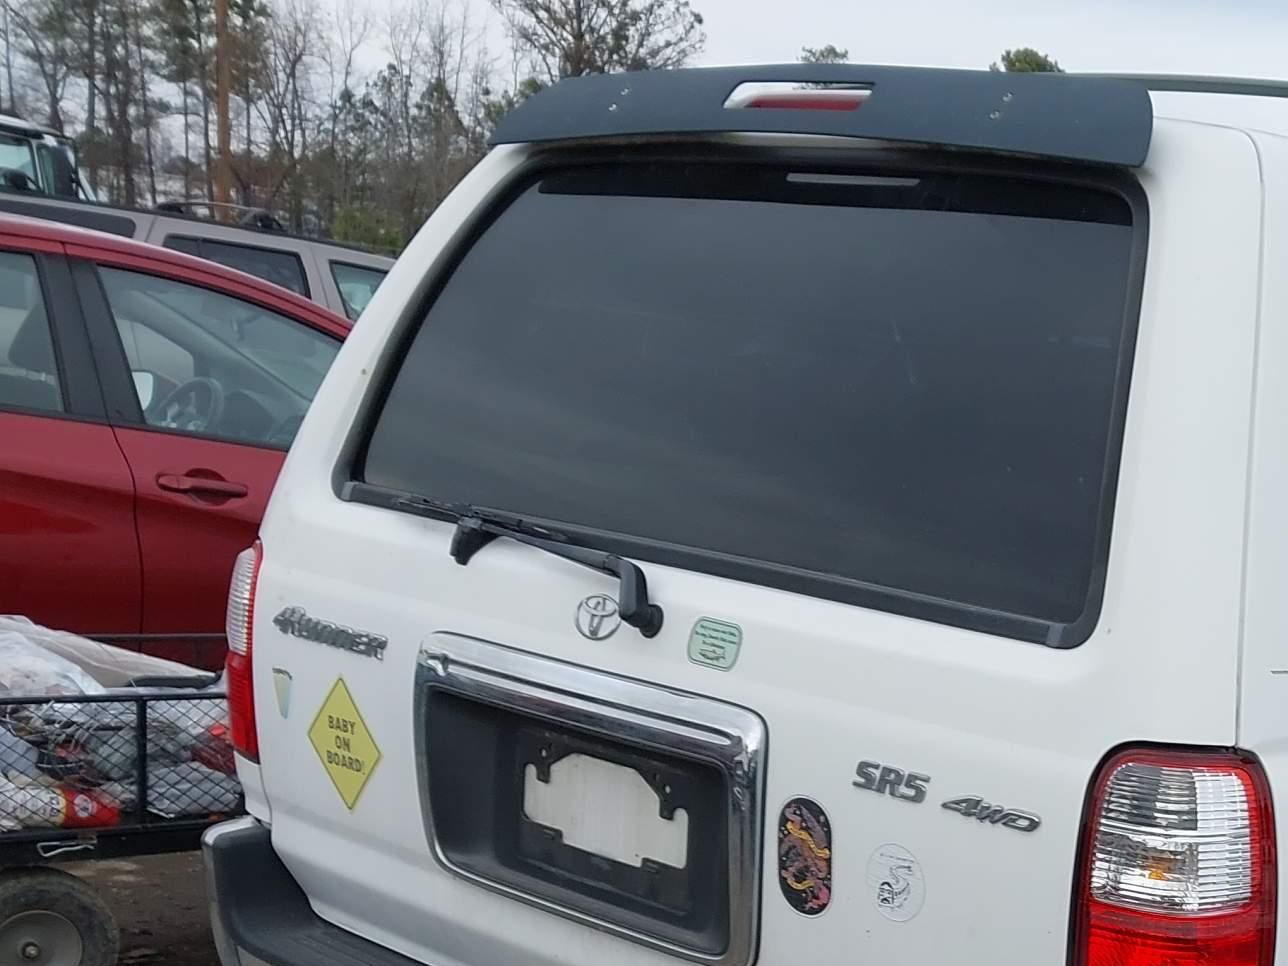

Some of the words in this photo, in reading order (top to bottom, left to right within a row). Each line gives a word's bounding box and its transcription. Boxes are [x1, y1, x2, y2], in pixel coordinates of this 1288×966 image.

[327, 714, 356, 735] BABY
[335, 734, 351, 753] ON
[326, 749, 366, 776] BOARD!
[852, 758, 932, 804] SR5
[940, 794, 1042, 833] 4WD
